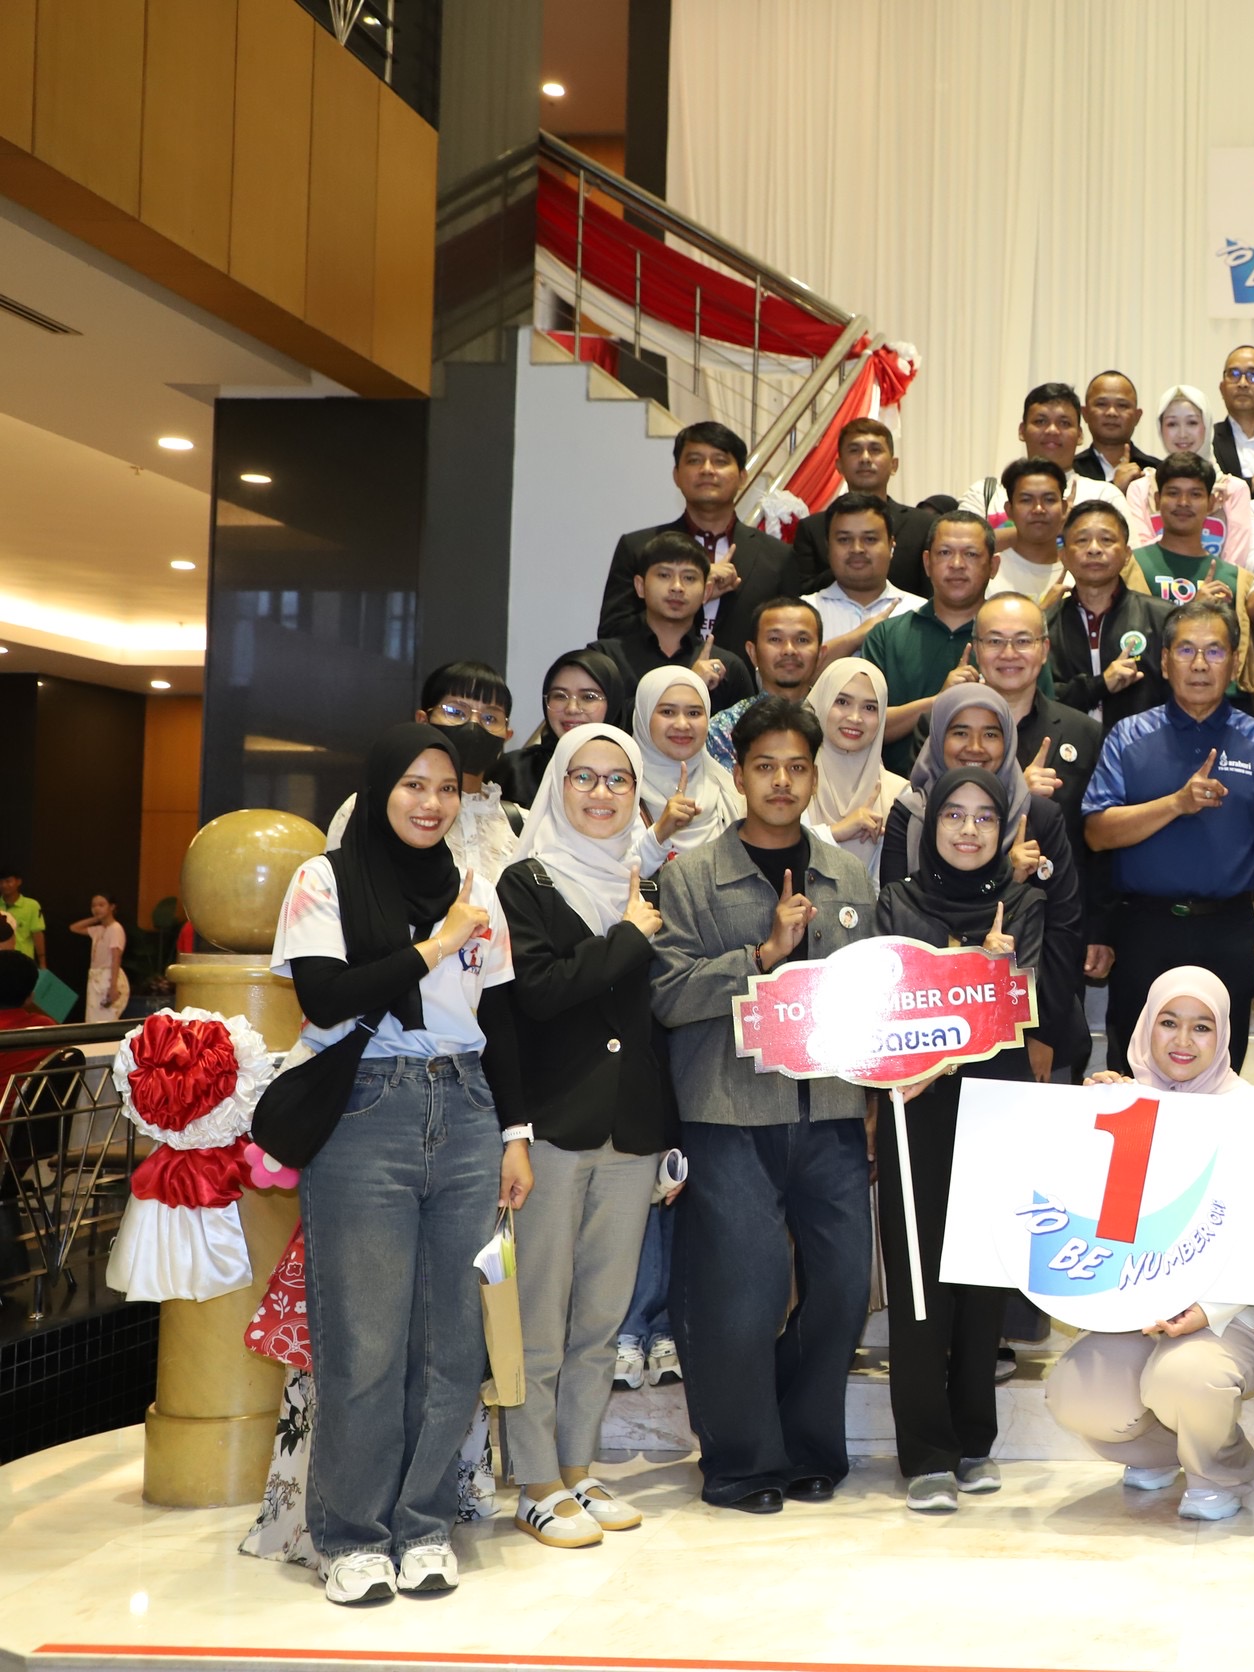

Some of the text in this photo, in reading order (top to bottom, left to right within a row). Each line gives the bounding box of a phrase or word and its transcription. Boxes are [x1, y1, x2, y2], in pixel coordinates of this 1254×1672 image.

[1216, 238, 1254, 268] TO
[774, 1002, 805, 1023] TO
[948, 983, 997, 1006] ONE
[1094, 1098, 1160, 1244] 1
[1014, 1195, 1070, 1235] TO
[1048, 1237, 1113, 1280] BE
[1118, 1222, 1216, 1290] NUMBER
